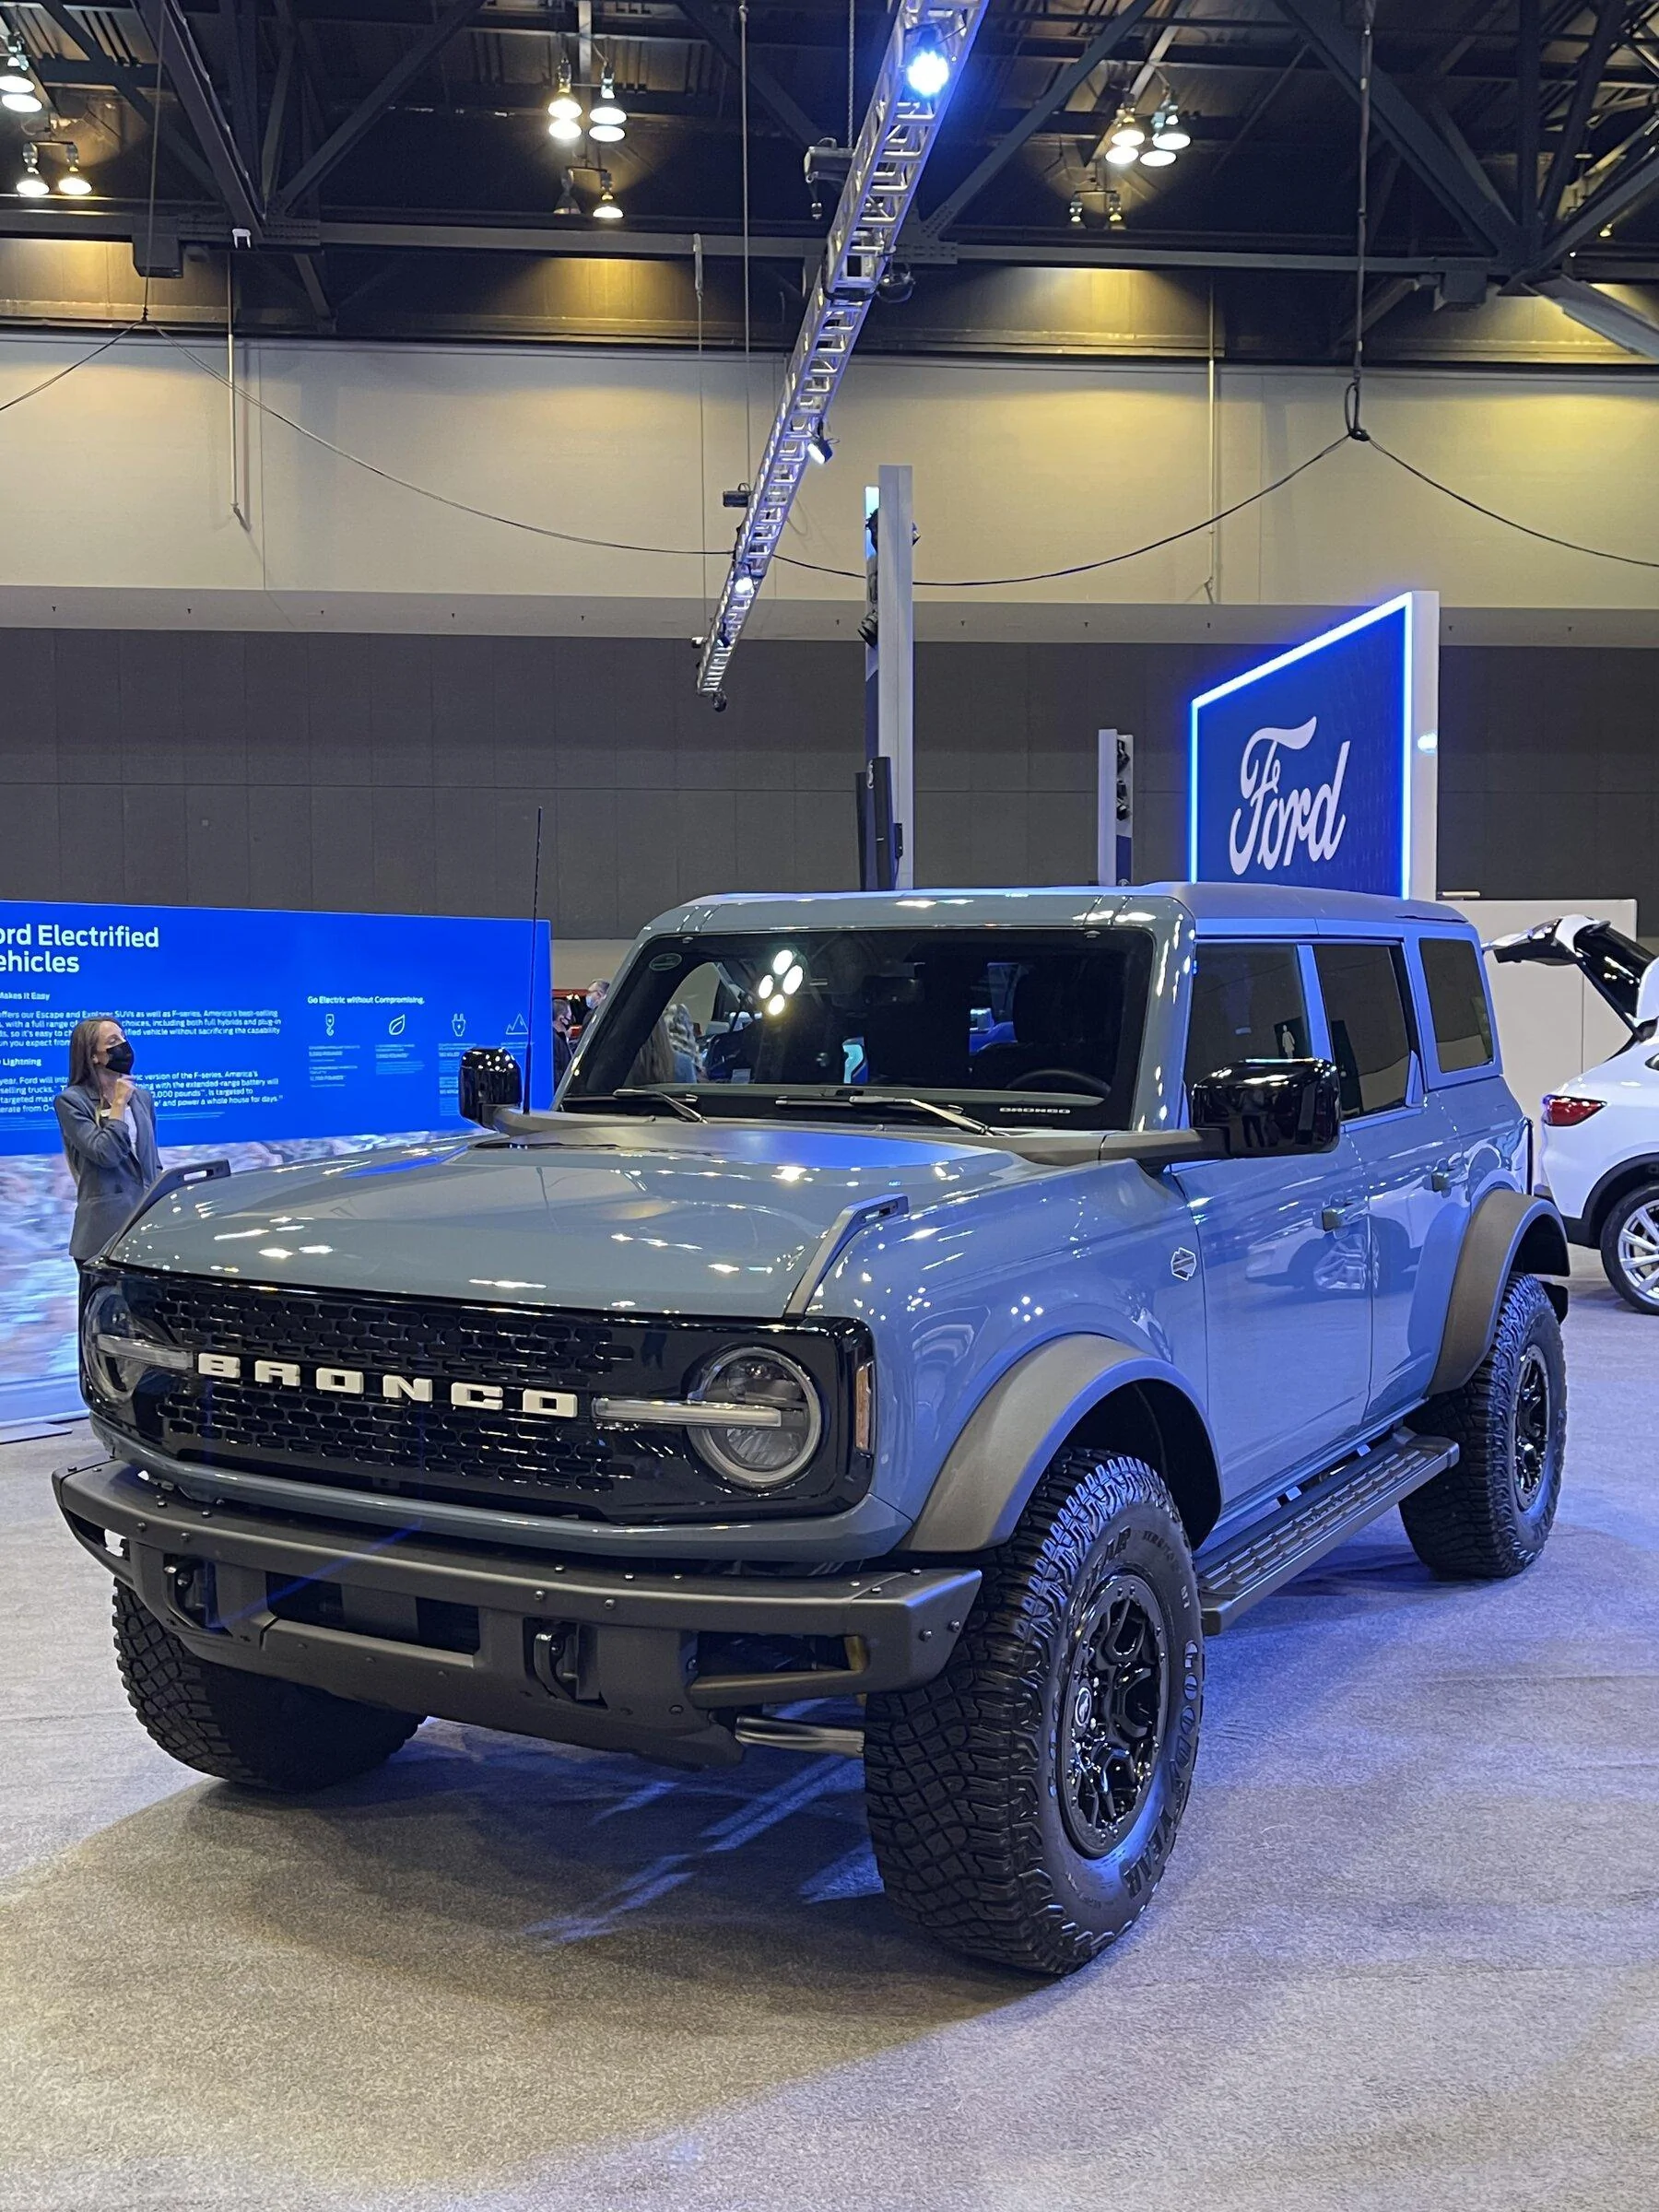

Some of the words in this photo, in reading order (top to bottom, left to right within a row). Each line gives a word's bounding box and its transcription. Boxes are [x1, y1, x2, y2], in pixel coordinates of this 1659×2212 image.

[1230, 716, 1351, 876] Ford
[0, 924, 31, 946] ord
[38, 924, 159, 948] Electrified
[0, 949, 80, 973] ehicles
[31, 992, 51, 1002] Easy
[36, 1010, 64, 1019] Escape
[6, 1020, 23, 1029] with
[31, 1019, 45, 1028] full
[186, 1018, 203, 1027] both
[218, 1018, 243, 1027] hybrids
[143, 1028, 169, 1036] vehicle
[26, 1039, 53, 1048] expect
[3, 1058, 42, 1066] Lightning
[19, 1077, 38, 1085] Ford
[156, 1081, 171, 1089] with
[172, 1080, 184, 1088] the
[241, 1078, 265, 1087] battery
[22, 1104, 42, 1112] from
[162, 1099, 177, 1107] and
[177, 1099, 200, 1107] power
[198, 1353, 578, 1418] BRONCO
